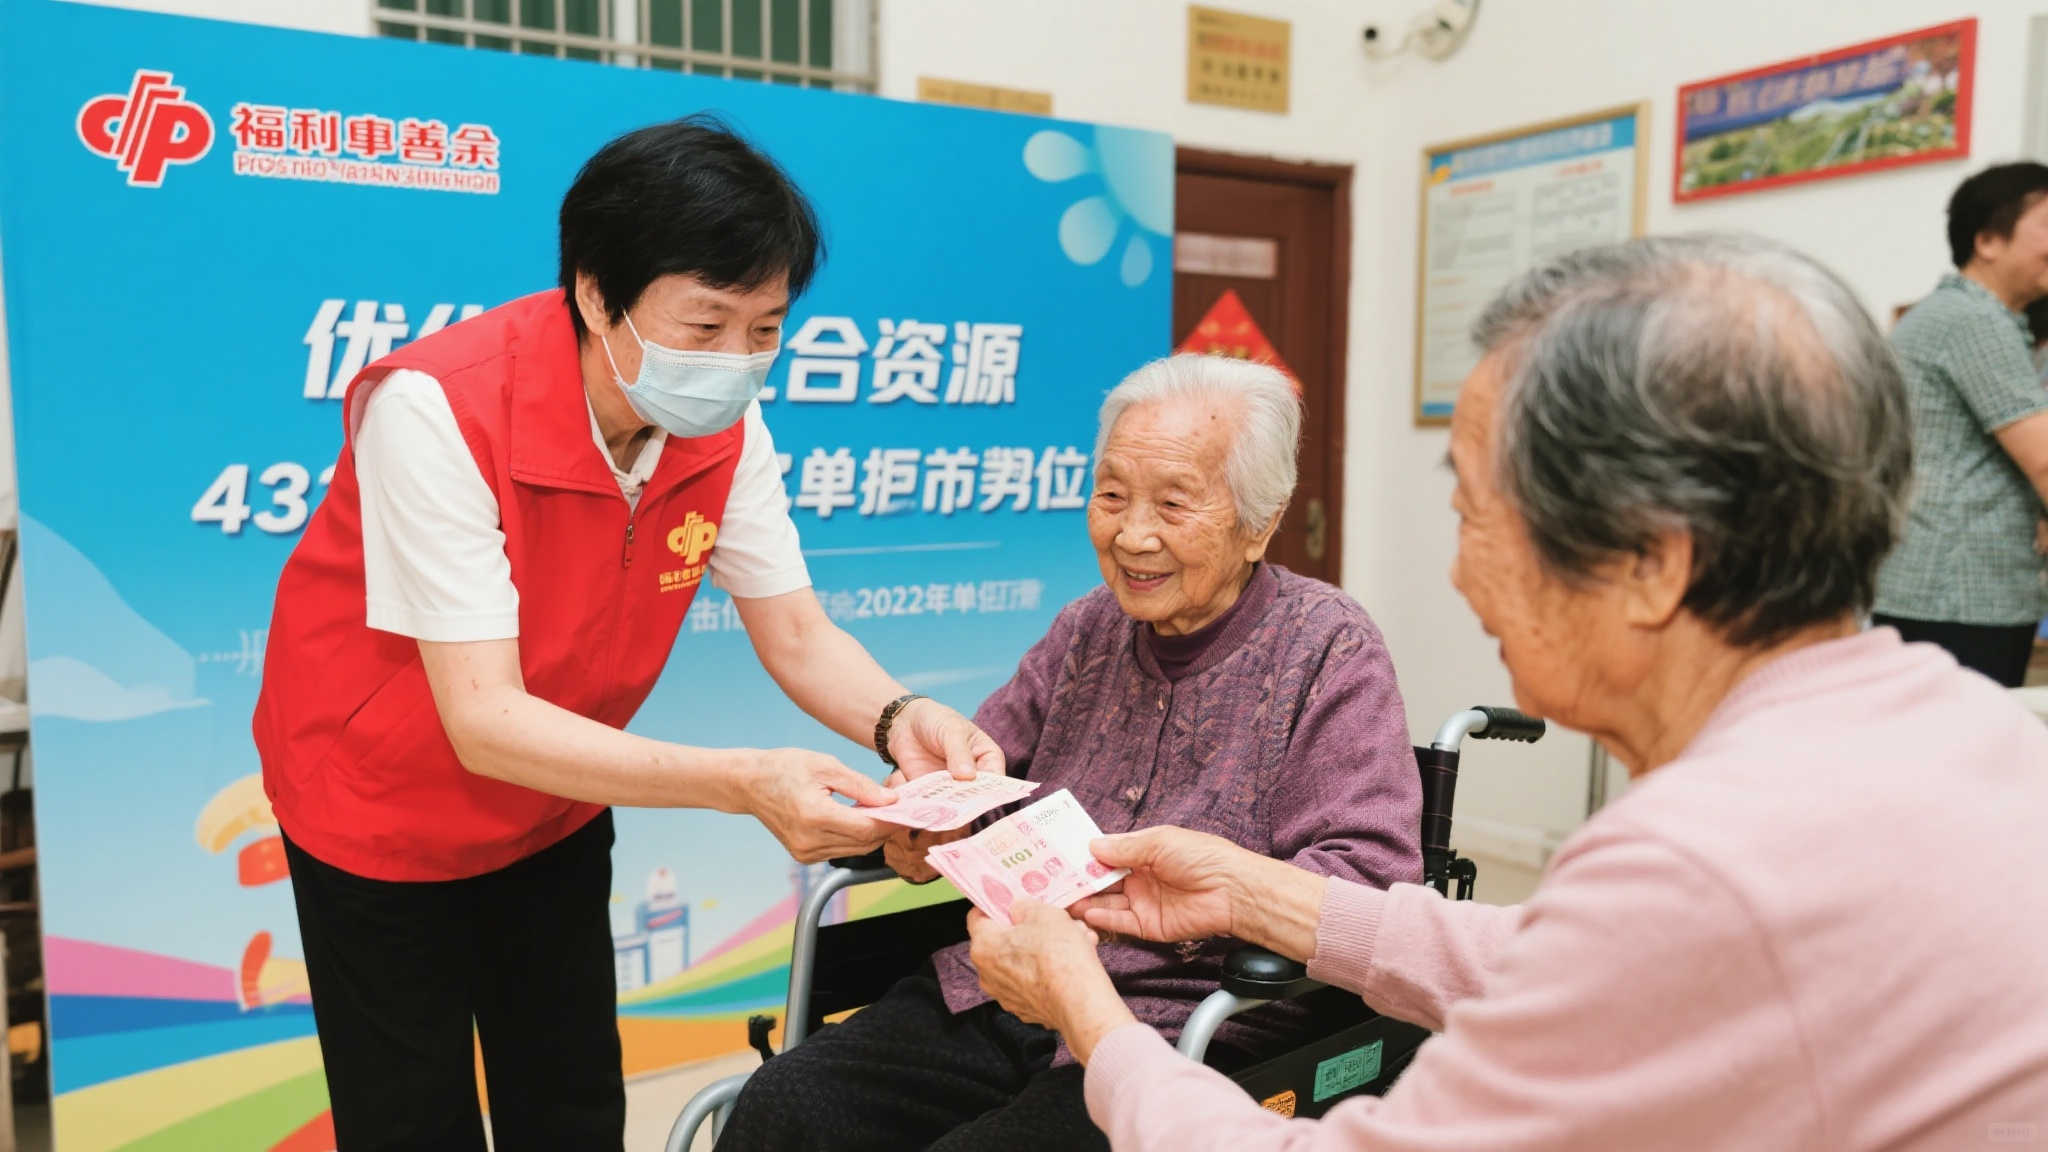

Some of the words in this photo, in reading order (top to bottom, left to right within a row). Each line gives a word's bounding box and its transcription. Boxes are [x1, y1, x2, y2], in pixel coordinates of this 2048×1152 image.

[758, 316, 1023, 404] 合资源
[190, 462, 338, 535] 43
